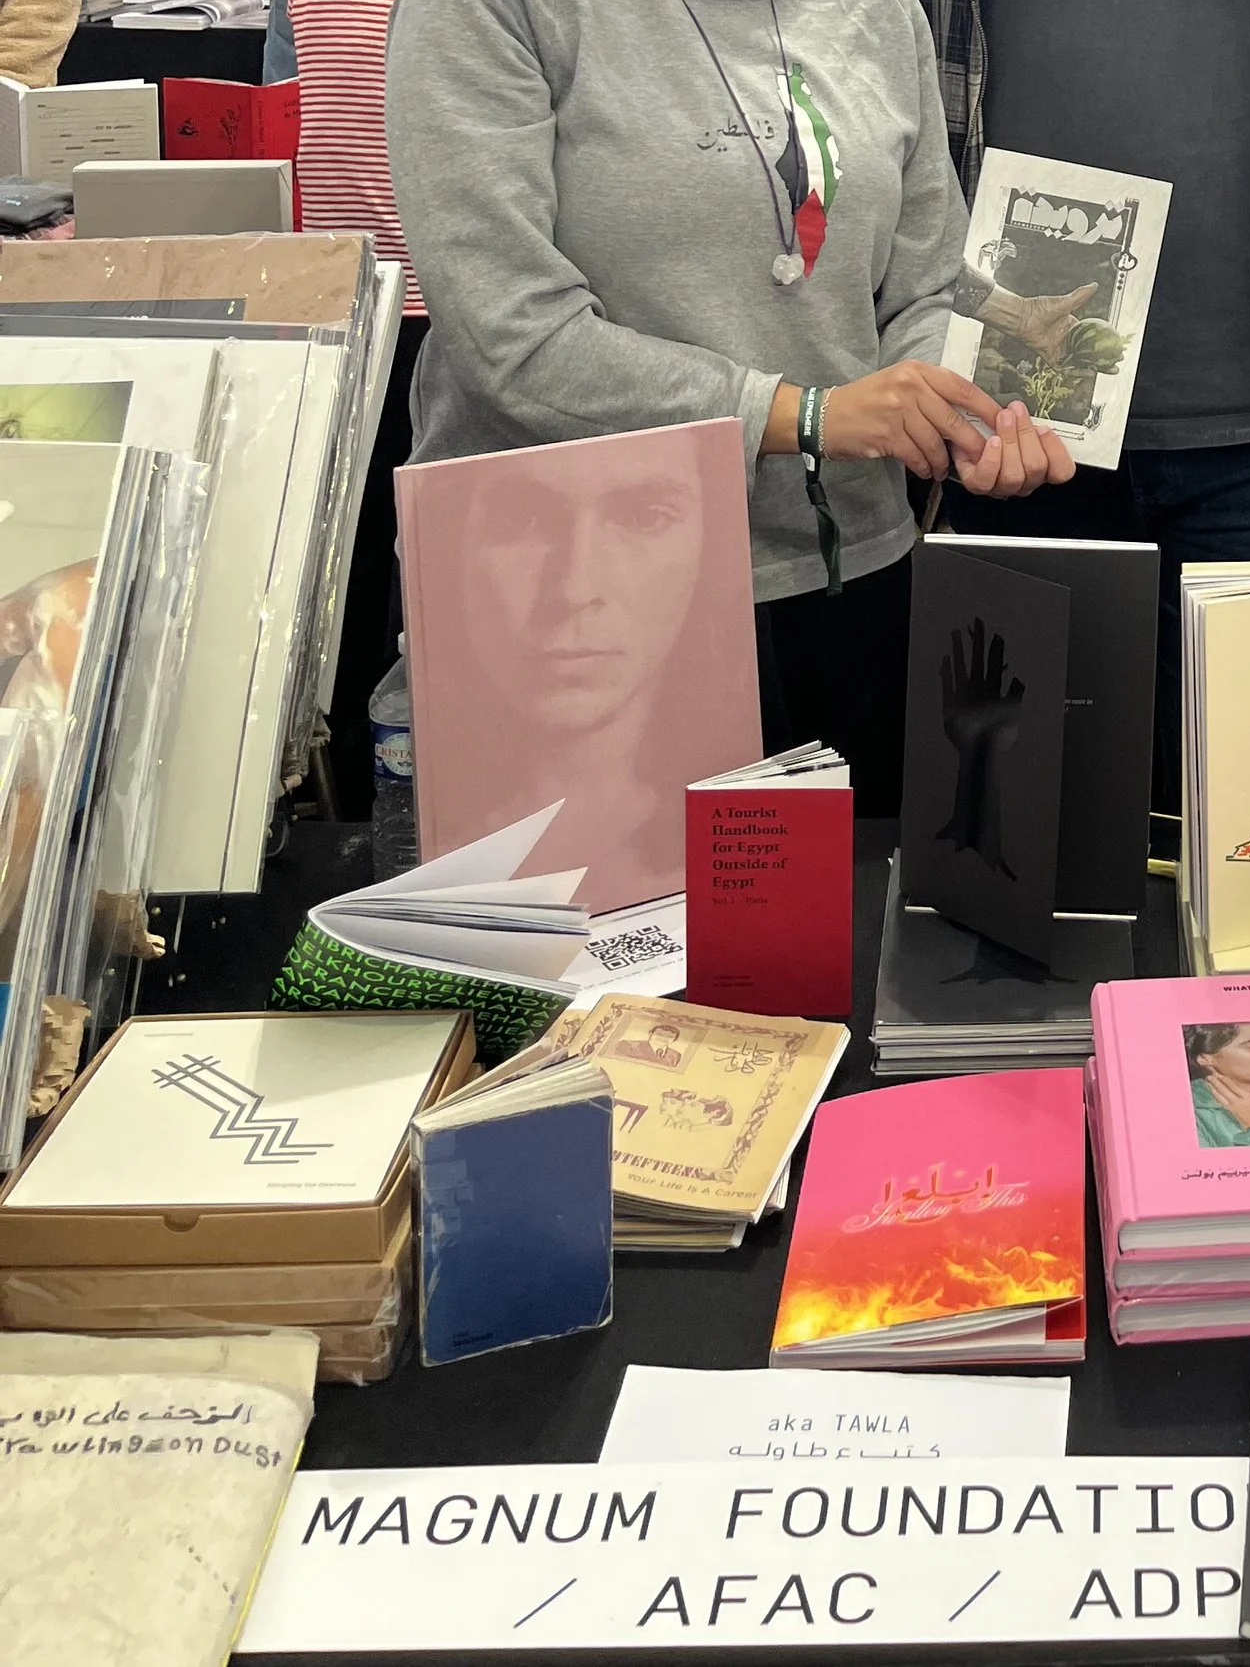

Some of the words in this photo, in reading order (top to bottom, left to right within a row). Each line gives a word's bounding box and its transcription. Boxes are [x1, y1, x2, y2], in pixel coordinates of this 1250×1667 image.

[712, 808, 722, 819] A
[725, 807, 777, 819] Tourist
[712, 824, 789, 836] Handbook
[712, 842, 734, 853] for
[737, 842, 780, 856] Egypt
[712, 859, 769, 871] Outside
[772, 857, 788, 870] of
[713, 876, 755, 889] Egypt
[627, 1173, 656, 1184] Your
[660, 1180, 683, 1190] Life
[701, 1187, 711, 1195] A
[715, 1187, 759, 1199] Career
[768, 1413, 813, 1432] aka
[835, 1413, 911, 1434] TAWLA
[302, 1491, 657, 1545] MAGNUM
[726, 1483, 1236, 1540] FOUNDATIO
[637, 1572, 878, 1627] AFAC
[1070, 1567, 1242, 1620] ADP
